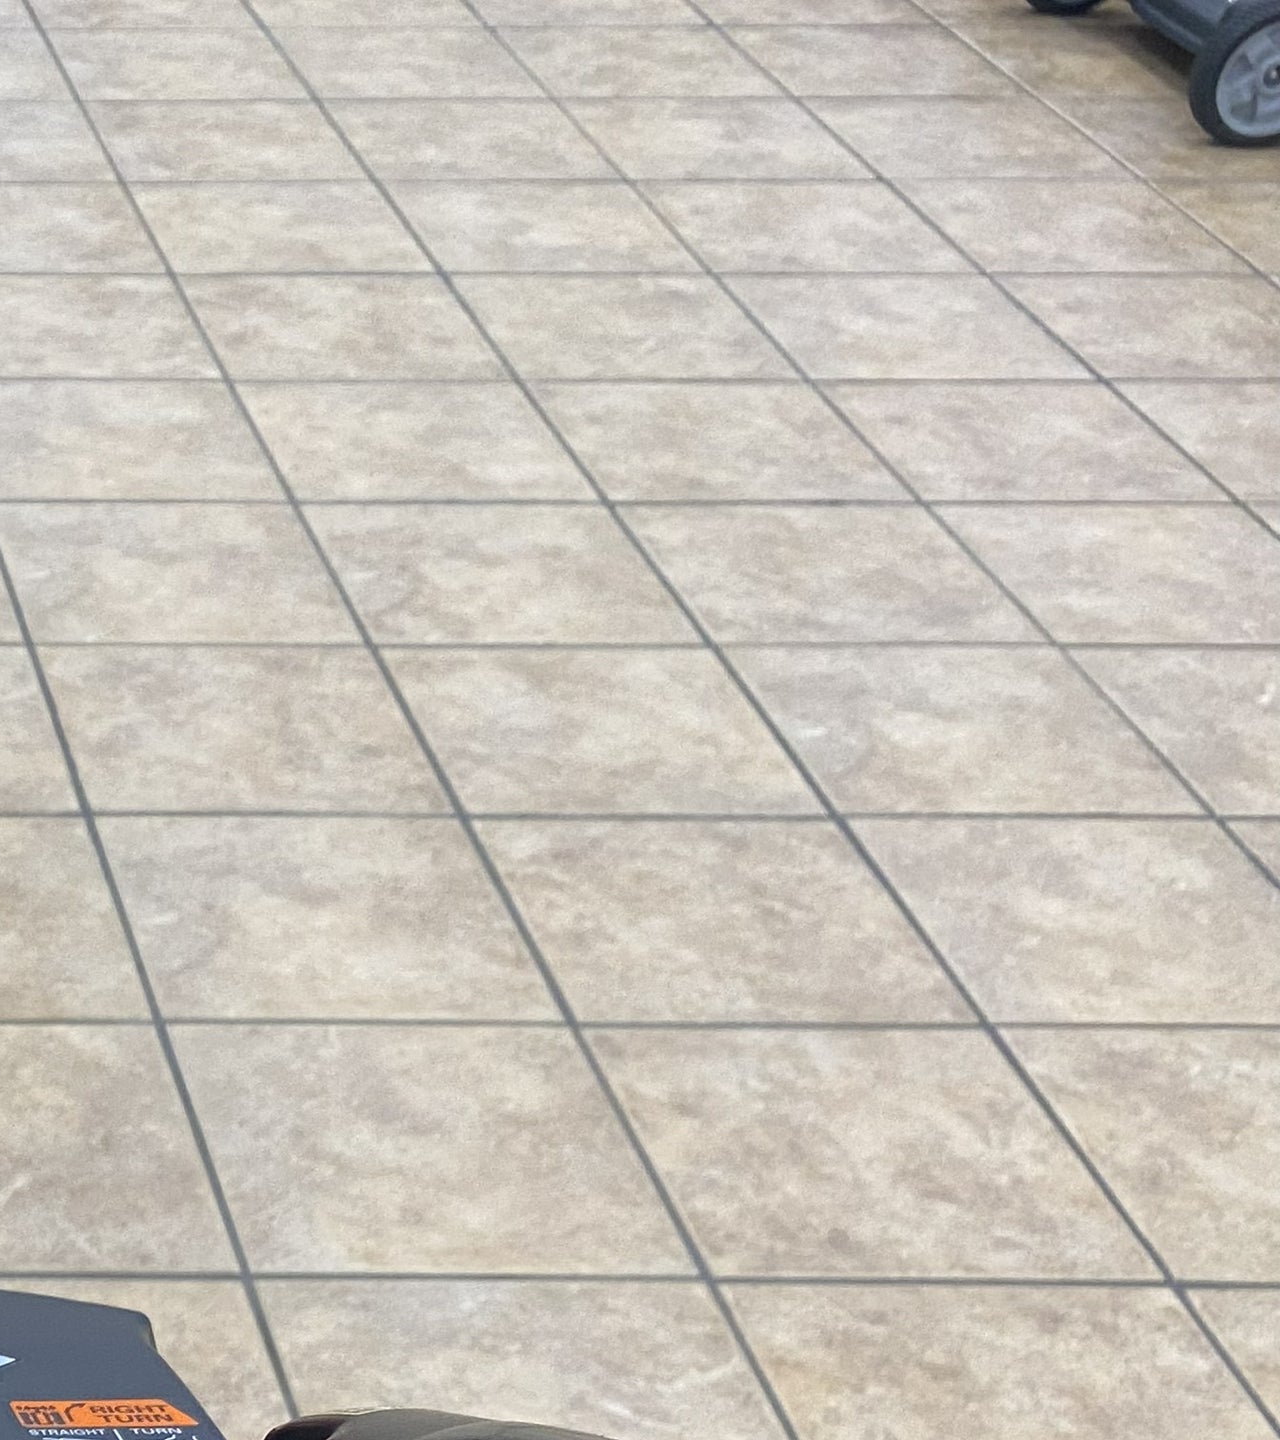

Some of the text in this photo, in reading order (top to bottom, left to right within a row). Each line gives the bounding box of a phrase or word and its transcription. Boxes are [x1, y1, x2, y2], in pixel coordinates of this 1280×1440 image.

[90, 1405, 169, 1414] RIGHT
[98, 1415, 174, 1423] TURN
[28, 1428, 105, 1436] STRAIGHT
